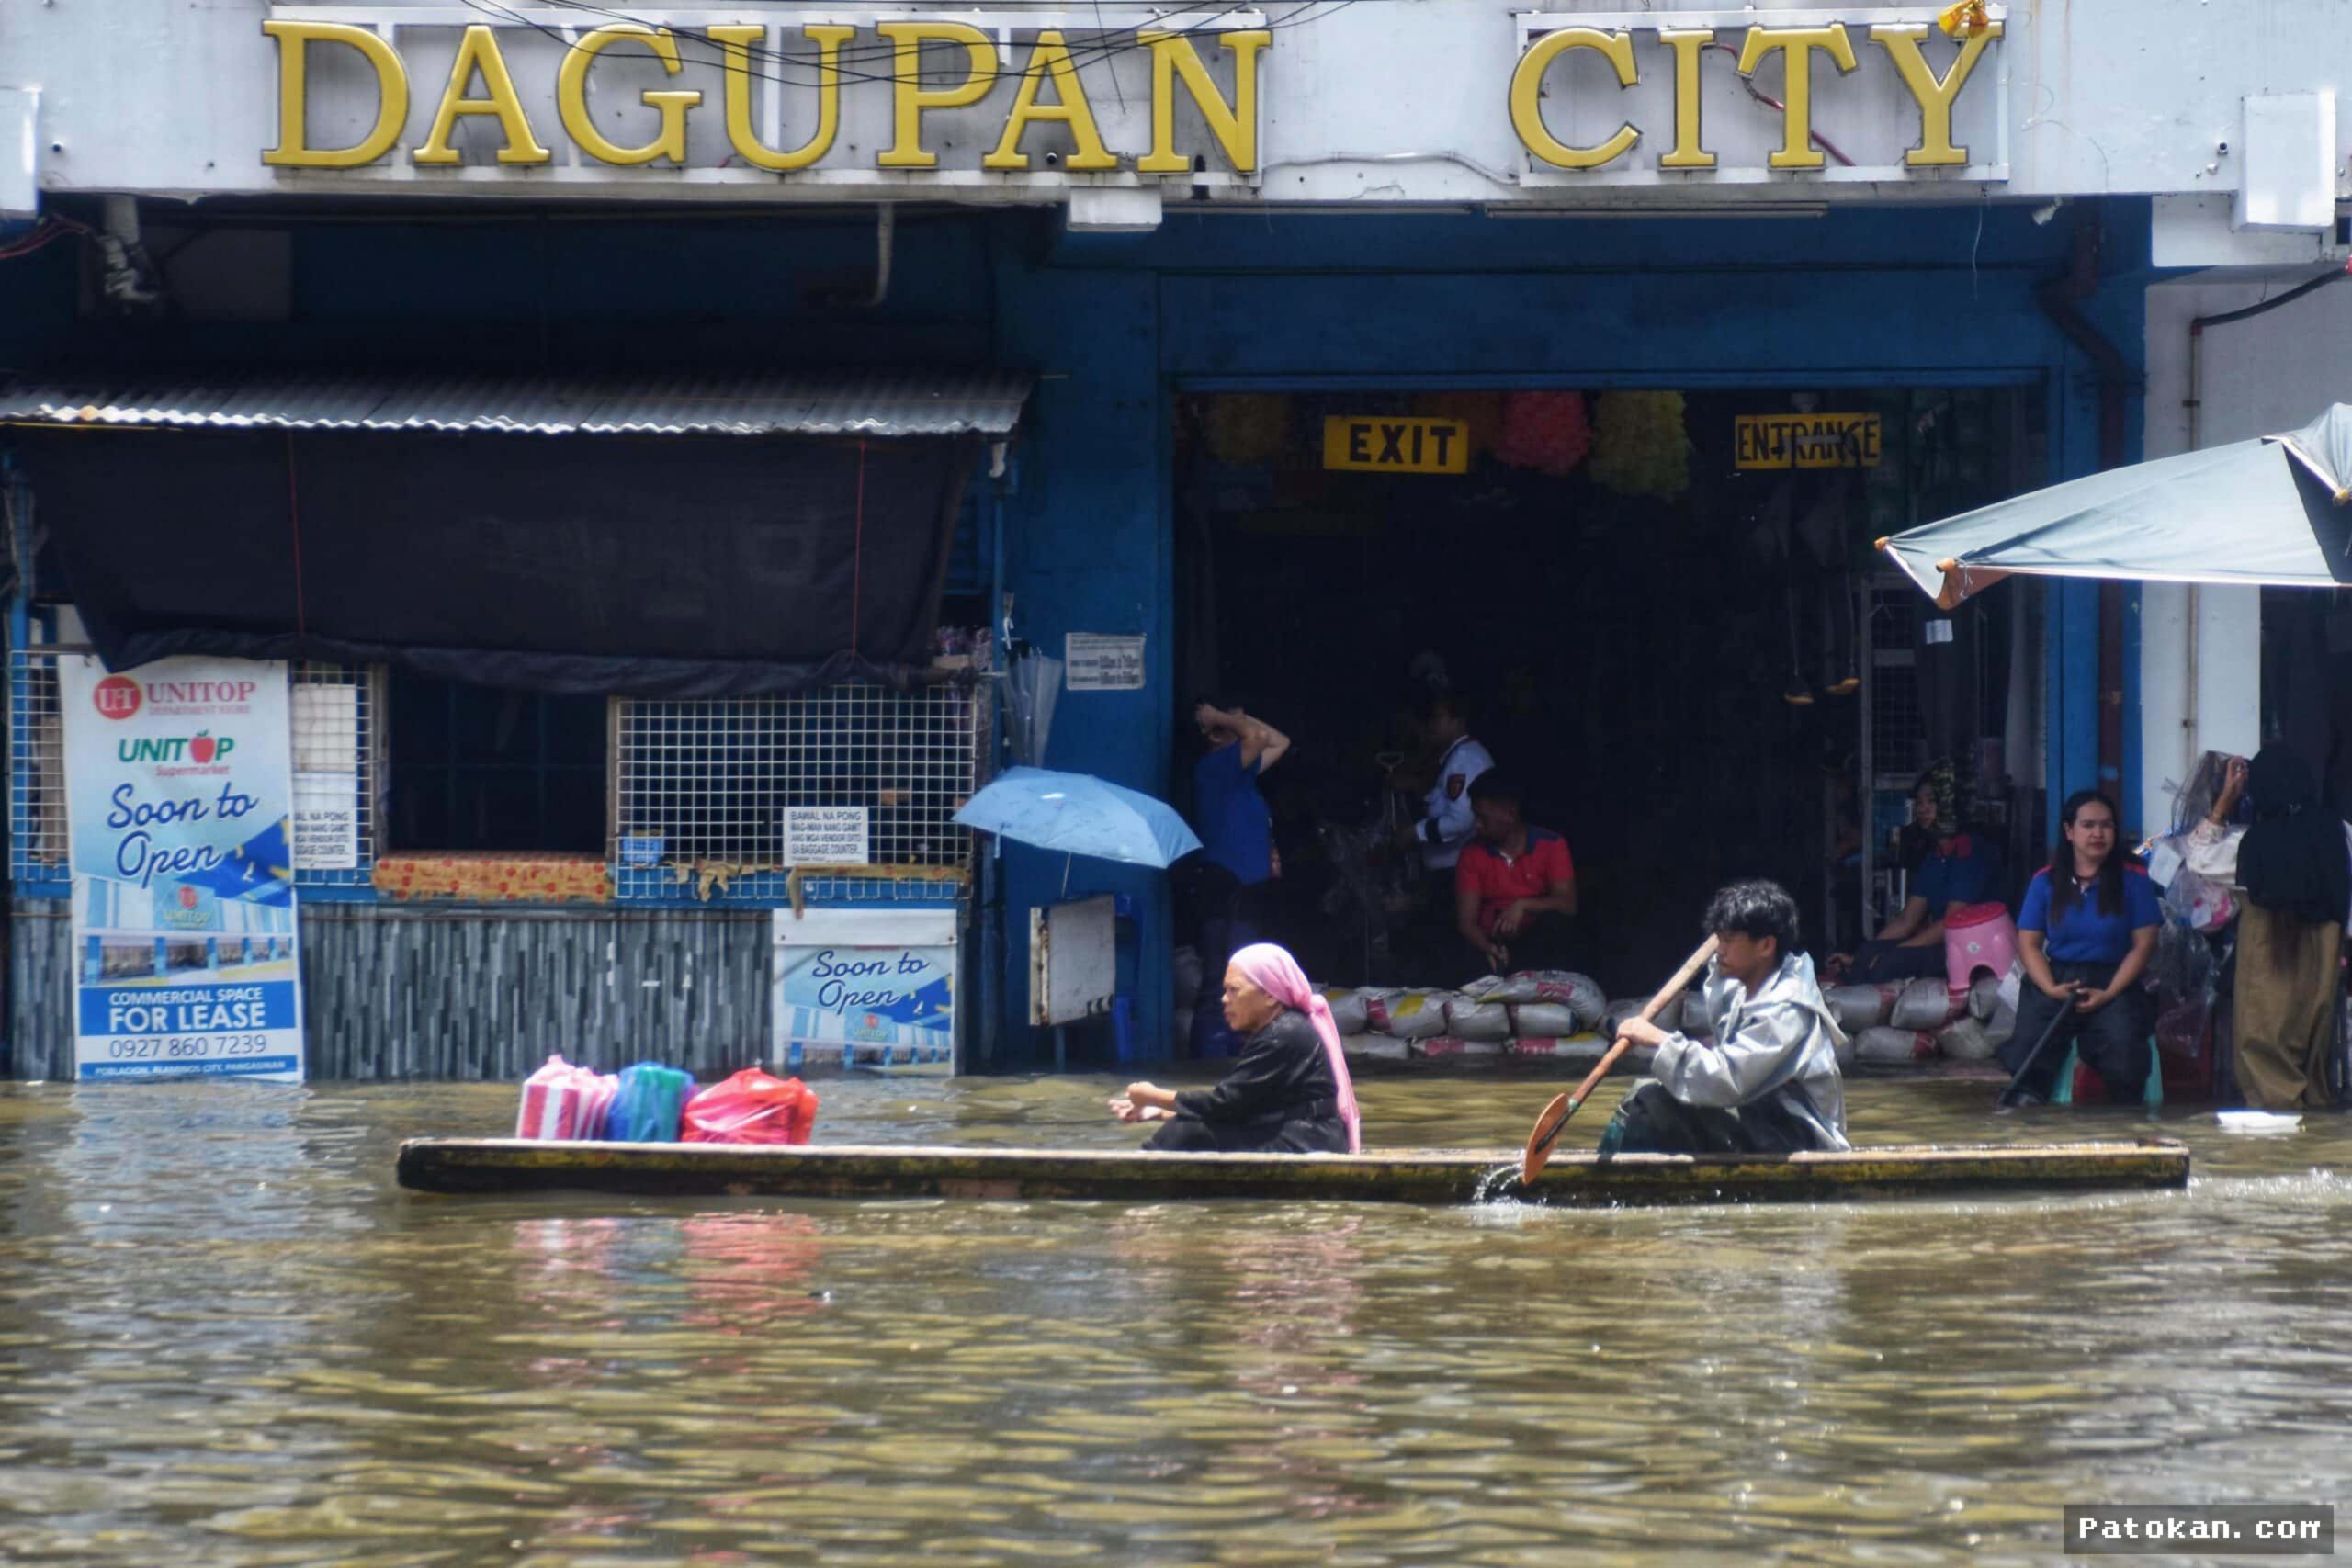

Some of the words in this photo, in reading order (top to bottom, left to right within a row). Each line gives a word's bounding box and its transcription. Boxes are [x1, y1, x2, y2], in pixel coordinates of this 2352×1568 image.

[262, 19, 1272, 175] DAGUPAN
[1509, 21, 2005, 172] CITY
[1350, 423, 1456, 466] EXIT
[1737, 420, 1879, 462] ENTRANCE
[146, 682, 256, 703] UNITOP
[107, 783, 209, 829] Soon
[216, 781, 259, 818] to
[117, 829, 222, 890] Open
[812, 950, 891, 978] Soon
[898, 951, 931, 974] to
[109, 989, 214, 1006] COMMERCIAL
[217, 987, 263, 1002] SPACE
[818, 979, 899, 1016] Open
[109, 1006, 169, 1032] FOR
[178, 1002, 266, 1030] LEASE
[109, 1039, 162, 1057] 0927
[168, 1036, 208, 1056] 860
[215, 1034, 267, 1055] 7239
